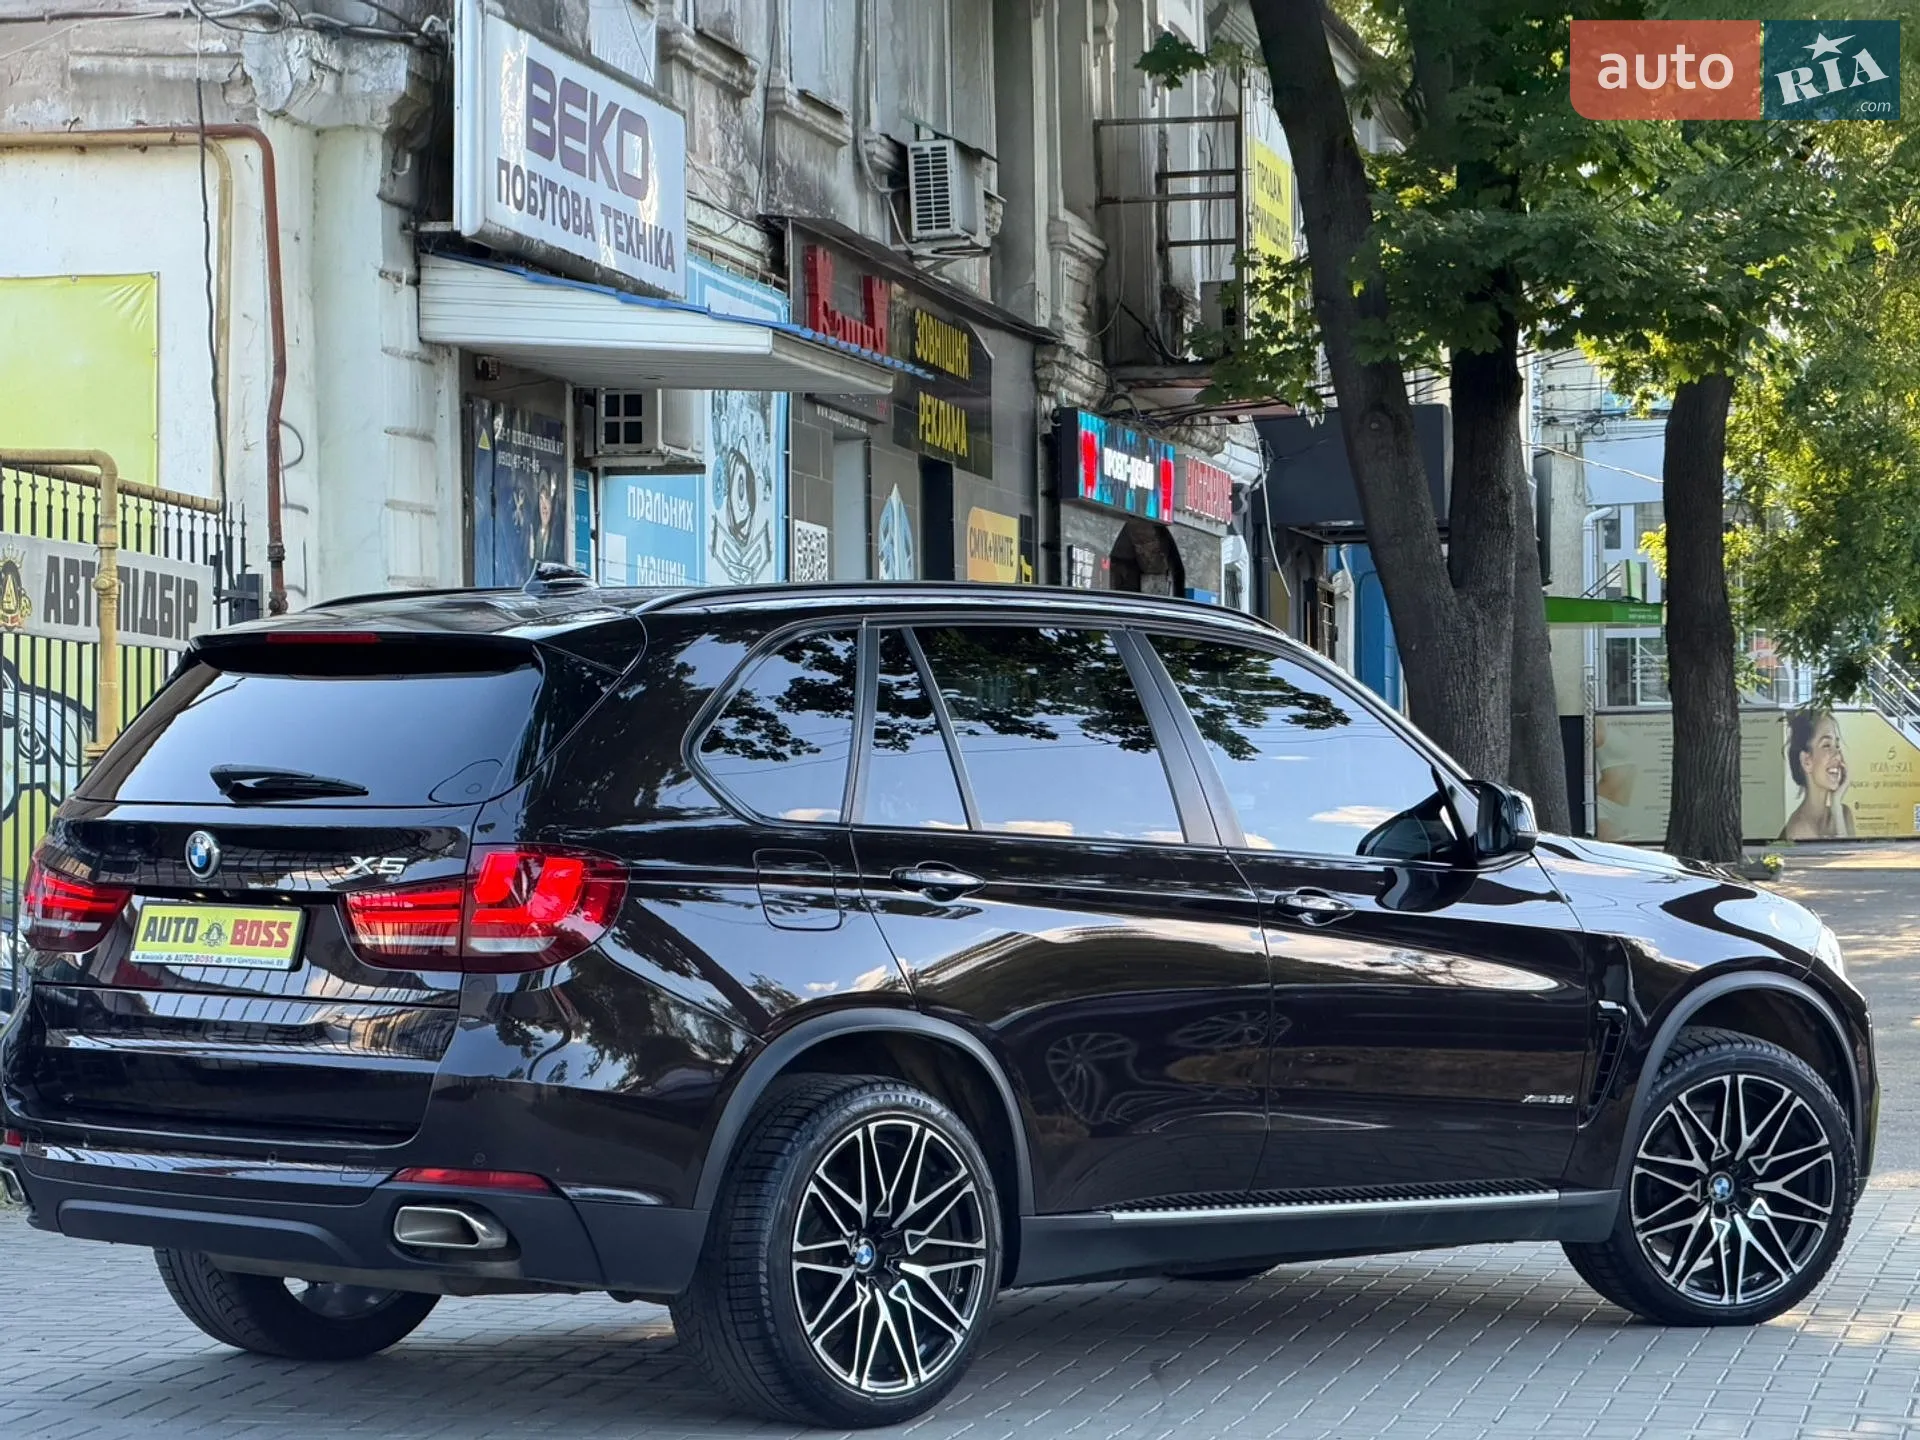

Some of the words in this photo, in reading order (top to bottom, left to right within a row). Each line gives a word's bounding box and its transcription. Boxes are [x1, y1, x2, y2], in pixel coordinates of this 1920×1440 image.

[526, 57, 650, 201] BEKO
[498, 157, 596, 242] ПОБУТОВА
[600, 202, 676, 273] ТЕХНІКА
[914, 307, 970, 380] ЗОВНІШНЯ
[918, 391, 968, 458] РЕКЛАМА
[626, 484, 694, 533] пральних
[43, 555, 199, 641] АВТПІДБІР
[346, 855, 409, 875] X5
[141, 915, 200, 944] AUTO
[229, 918, 293, 948] BOSS
